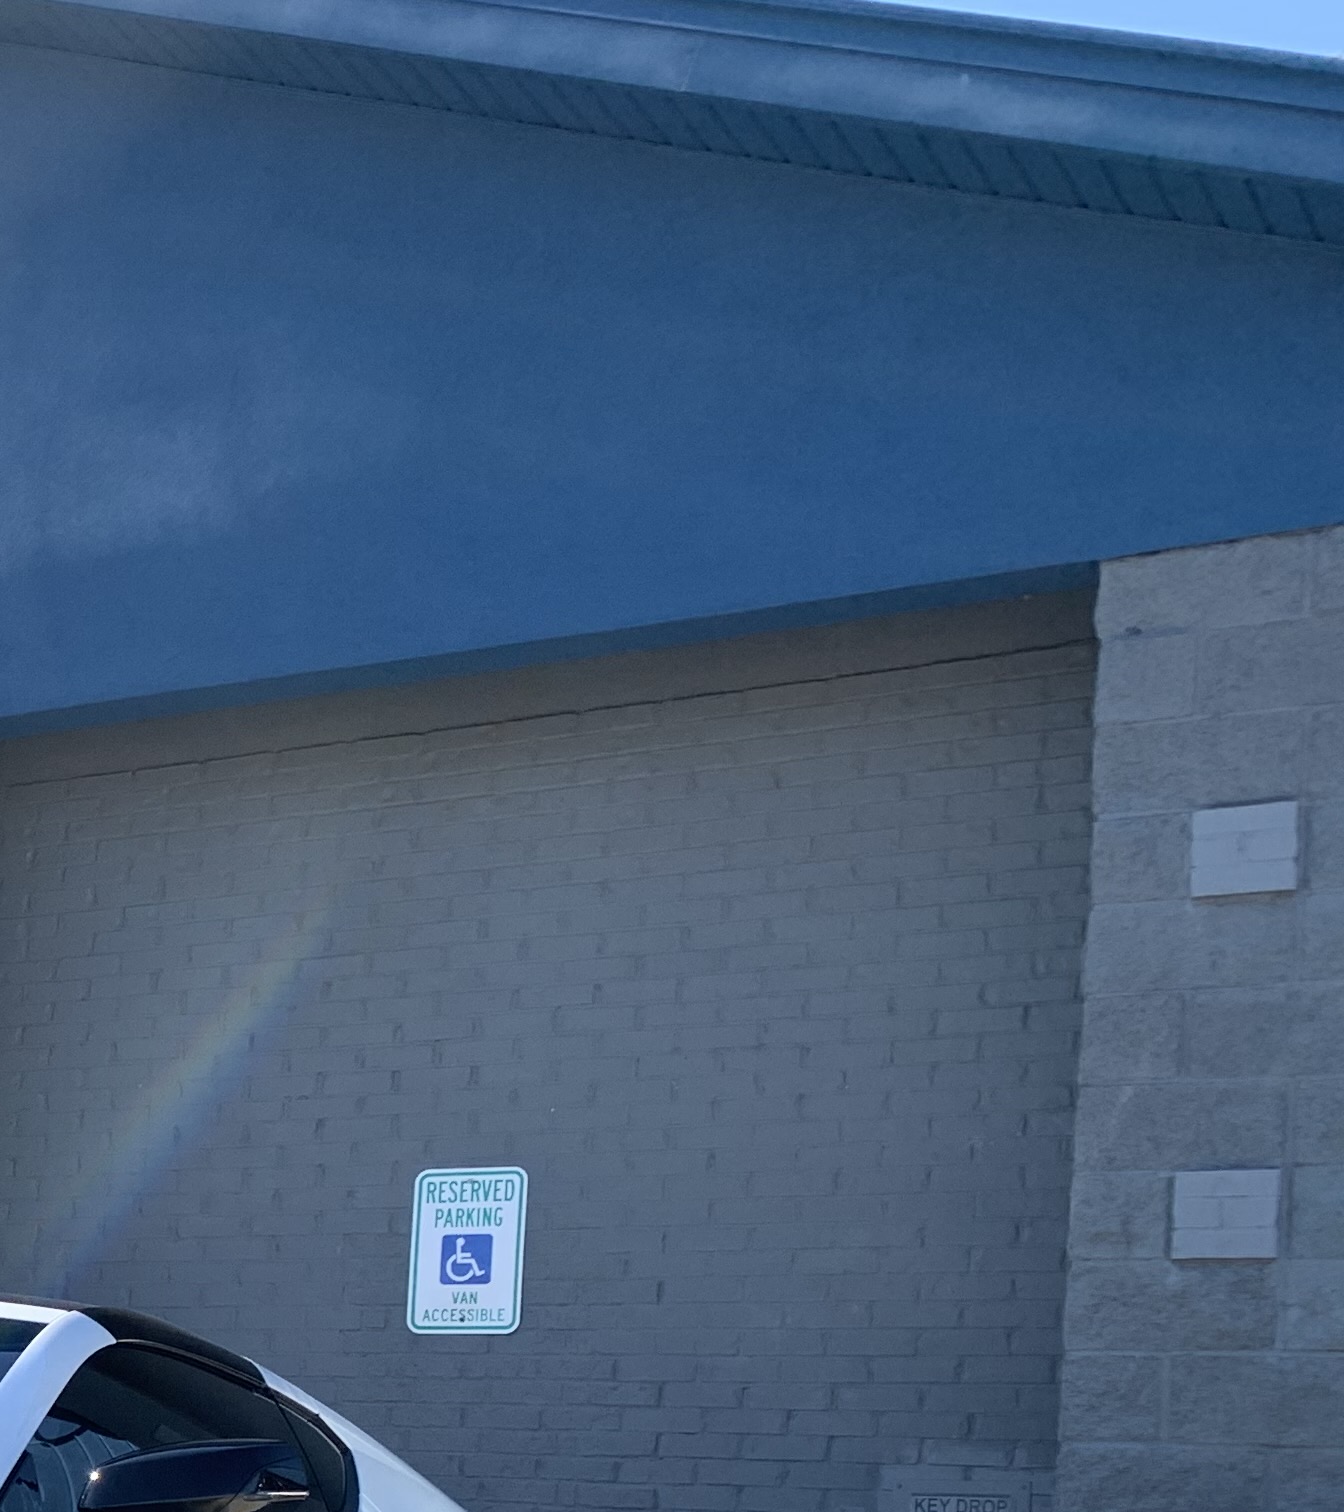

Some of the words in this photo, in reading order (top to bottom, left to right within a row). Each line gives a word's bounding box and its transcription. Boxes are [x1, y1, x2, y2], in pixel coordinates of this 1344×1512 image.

[426, 1179, 516, 1204] RESERVED
[434, 1207, 504, 1228] PARKING
[451, 1291, 478, 1304] VAN
[422, 1308, 506, 1322] ACCESSIBLE
